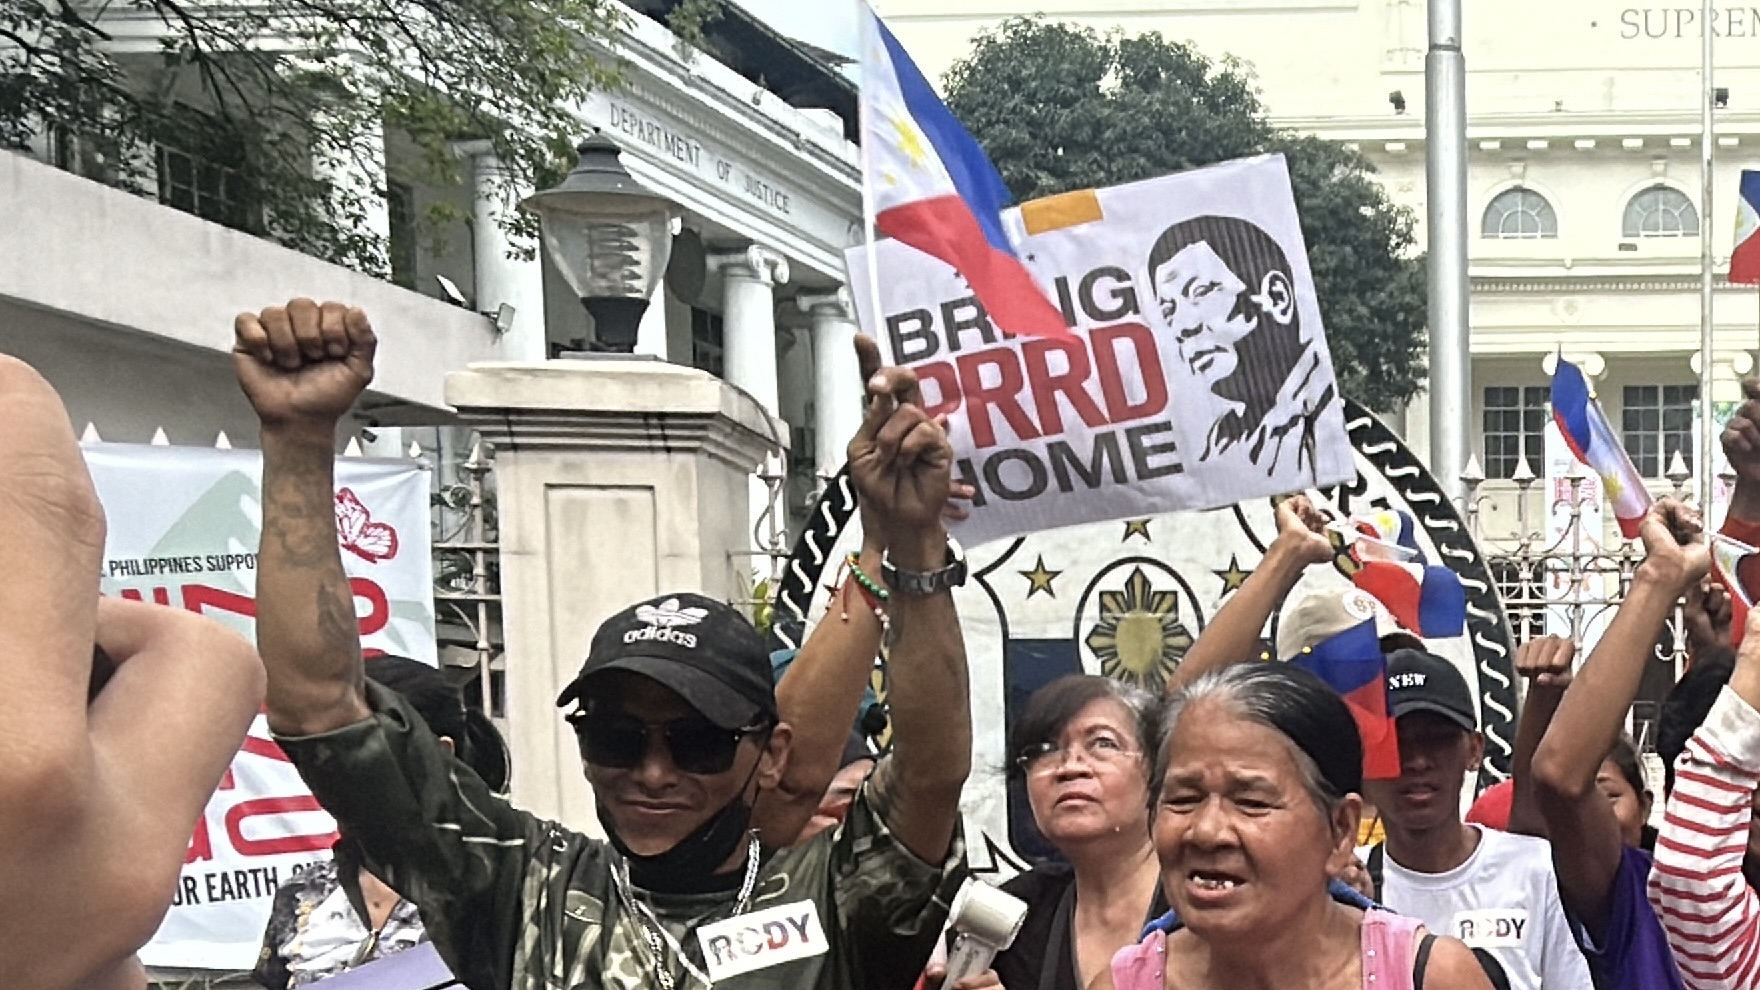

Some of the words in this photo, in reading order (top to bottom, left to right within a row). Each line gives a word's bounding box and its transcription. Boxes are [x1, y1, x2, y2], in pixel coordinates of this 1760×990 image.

[610, 102, 700, 168] DEPARTMENT
[716, 159, 732, 183] OF
[744, 174, 790, 214] JUSTICE
[886, 265, 1141, 366] BRG
[109, 557, 203, 577] PHILIPPINES
[206, 553, 258, 572] SUPPO
[624, 627, 698, 648] adidas
[1389, 673, 1425, 689] NEW
[205, 866, 278, 902] EARTH
